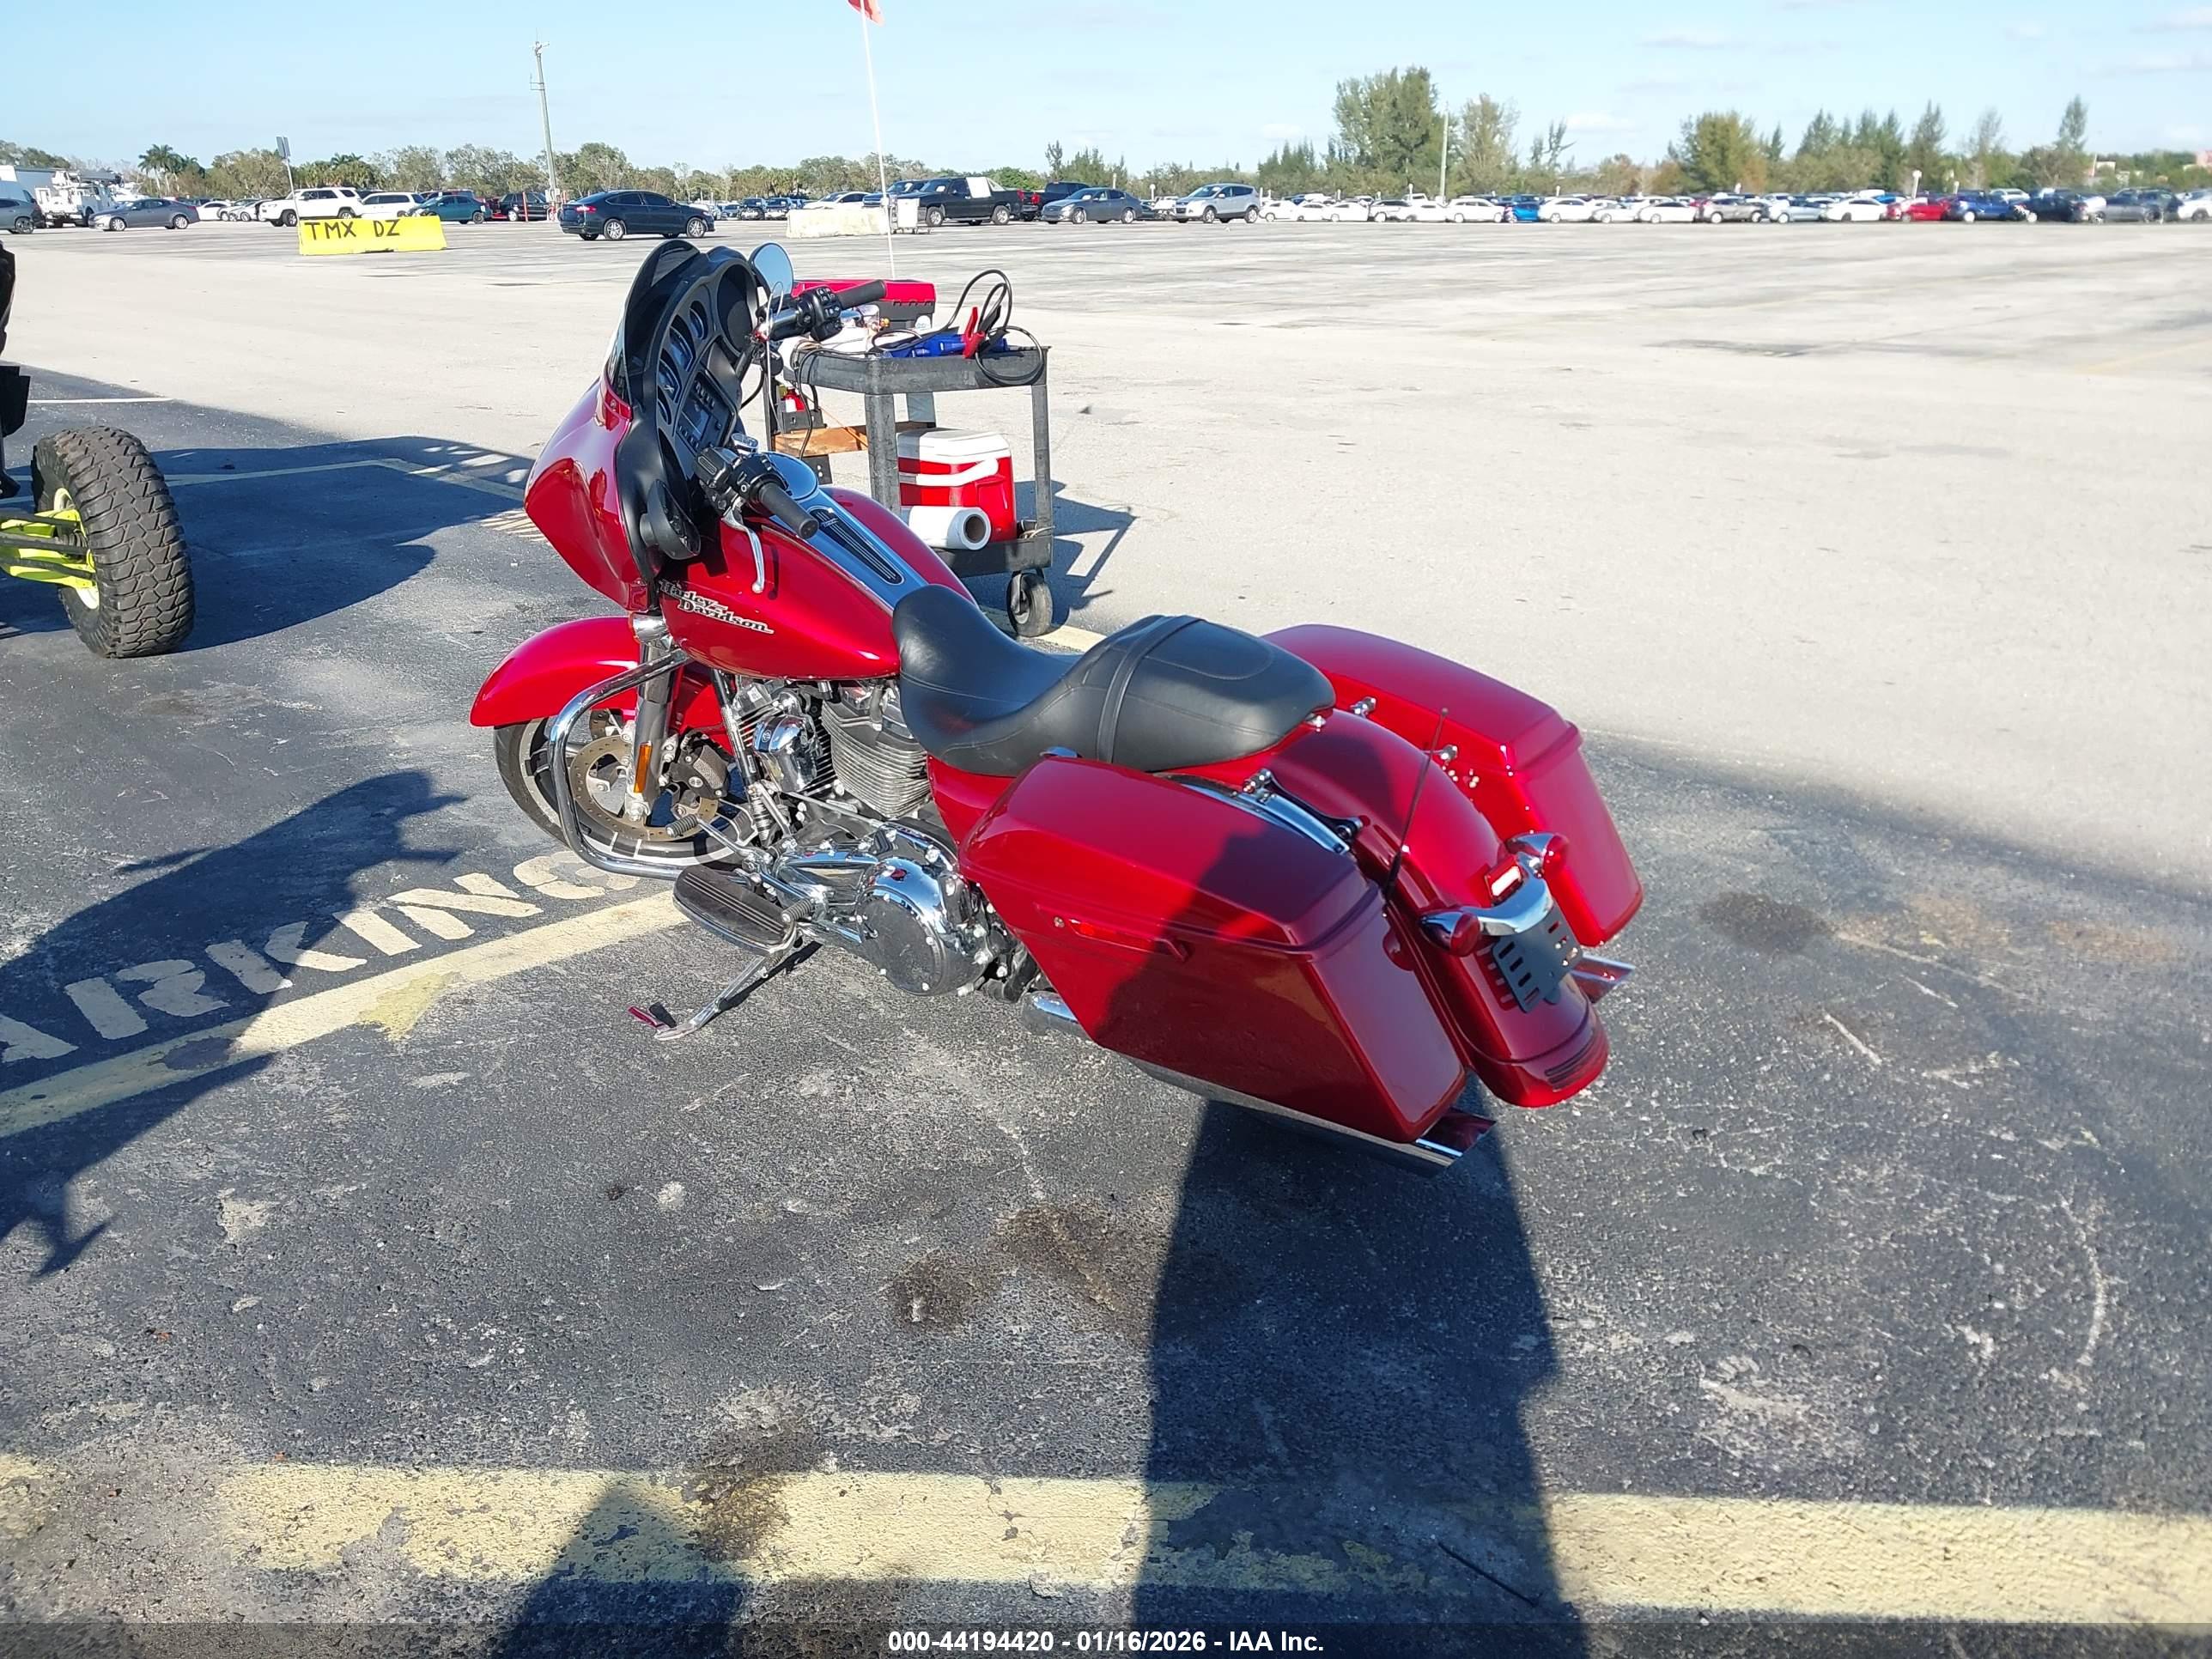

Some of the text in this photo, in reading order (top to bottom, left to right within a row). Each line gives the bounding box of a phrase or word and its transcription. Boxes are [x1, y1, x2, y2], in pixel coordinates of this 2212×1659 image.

[304, 218, 402, 240] TMX DZ
[678, 599, 775, 635] Davidson
